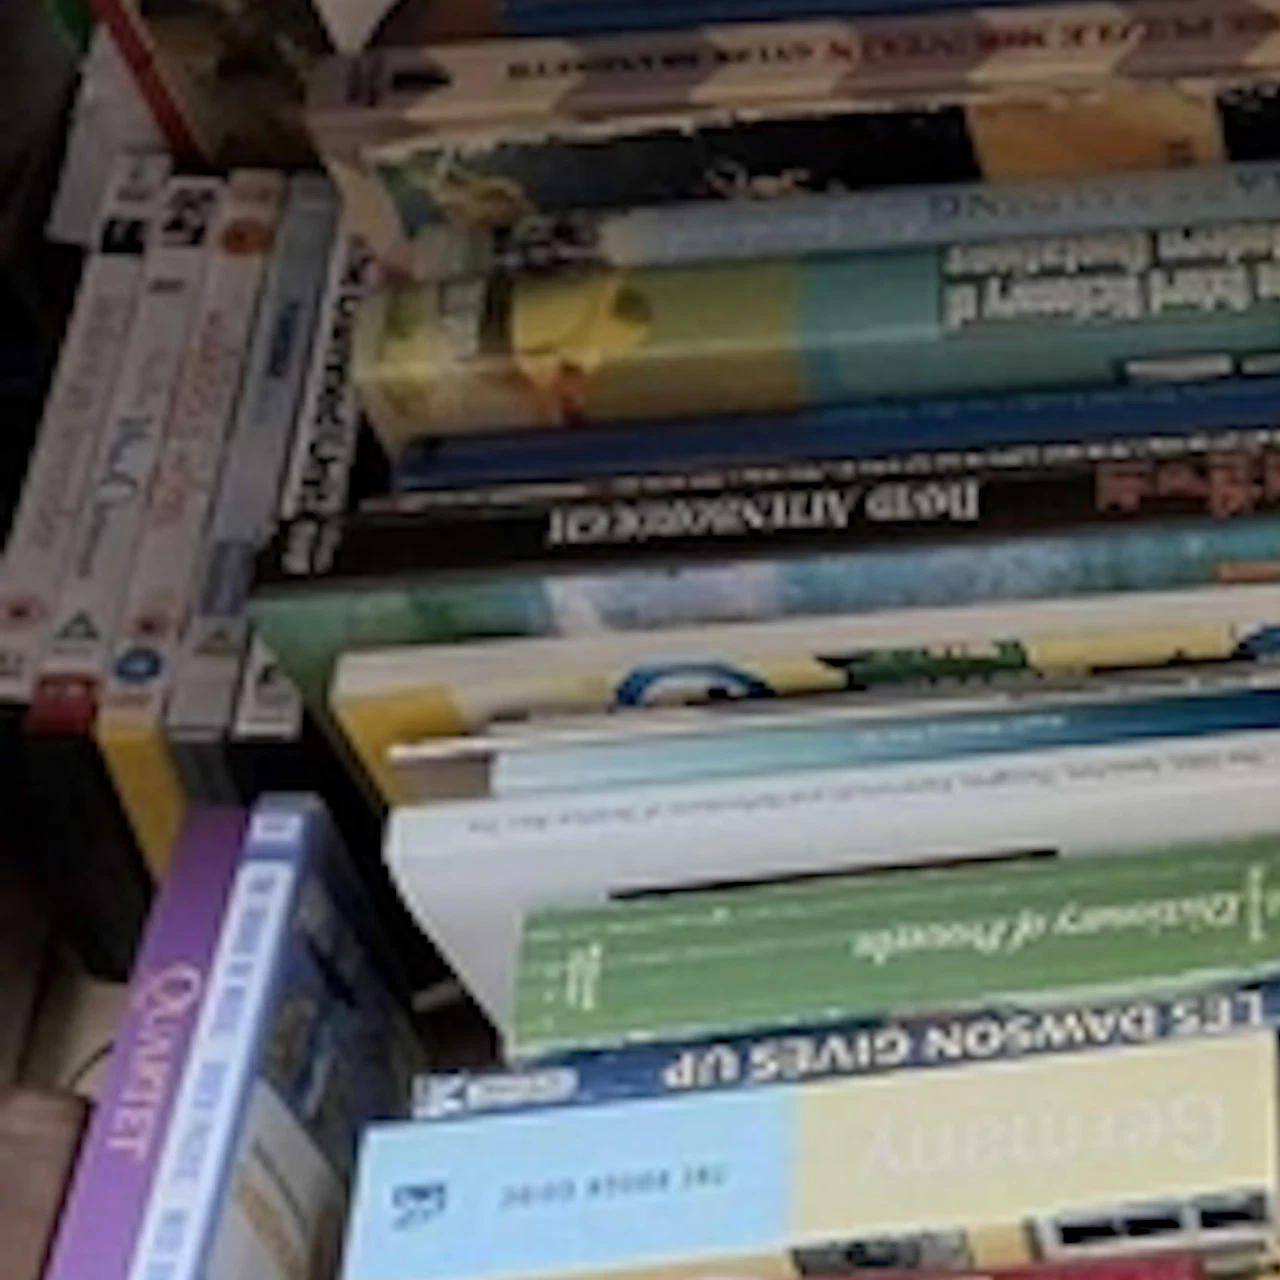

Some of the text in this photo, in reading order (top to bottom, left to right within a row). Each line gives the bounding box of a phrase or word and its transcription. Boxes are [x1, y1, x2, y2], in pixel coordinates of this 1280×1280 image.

[942, 228, 1152, 290] Quotations
[979, 263, 1144, 333] Dictionary
[547, 475, 983, 549] DAVID ATTENBOROUGH
[107, 958, 203, 1166] QUARTET
[659, 986, 1266, 1091] LES DAWSON GIVES UP
[857, 1082, 1229, 1197] Germany
